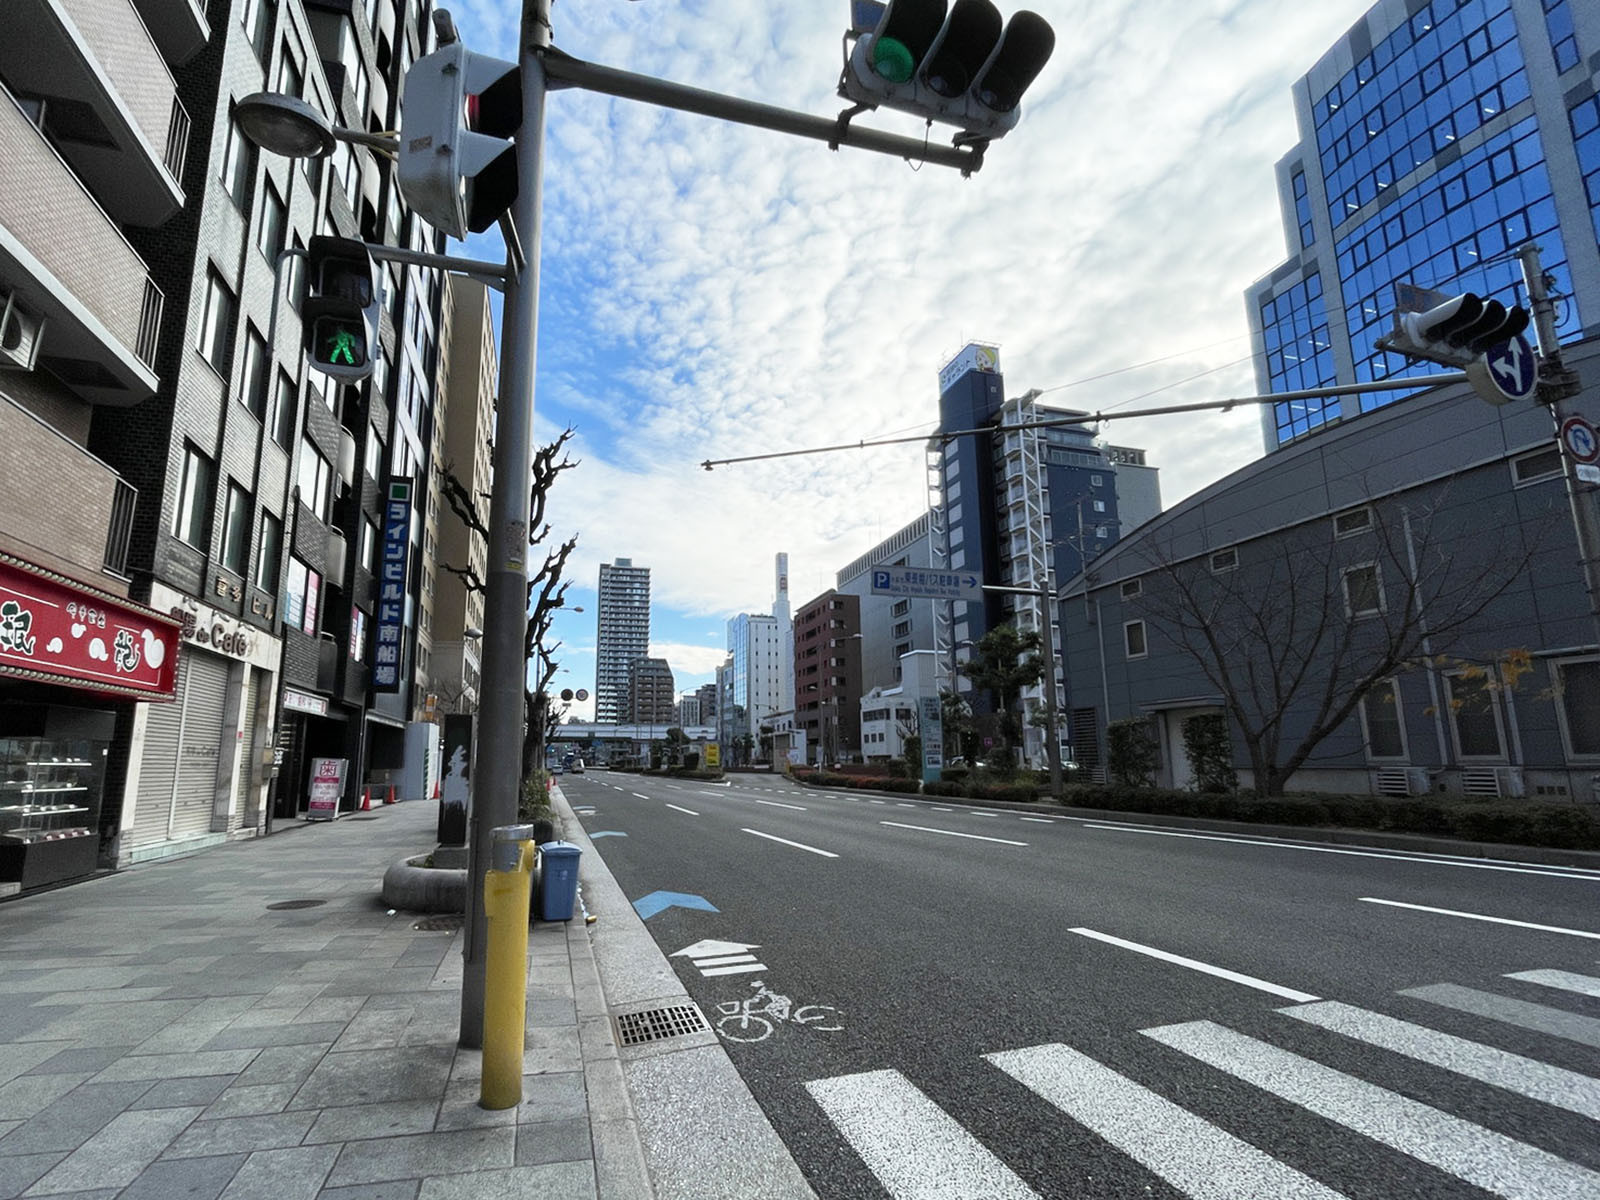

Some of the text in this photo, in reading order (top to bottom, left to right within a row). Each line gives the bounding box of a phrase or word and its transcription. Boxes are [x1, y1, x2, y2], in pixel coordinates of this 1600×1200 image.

[375, 503, 405, 685] ラインビルド南船場
